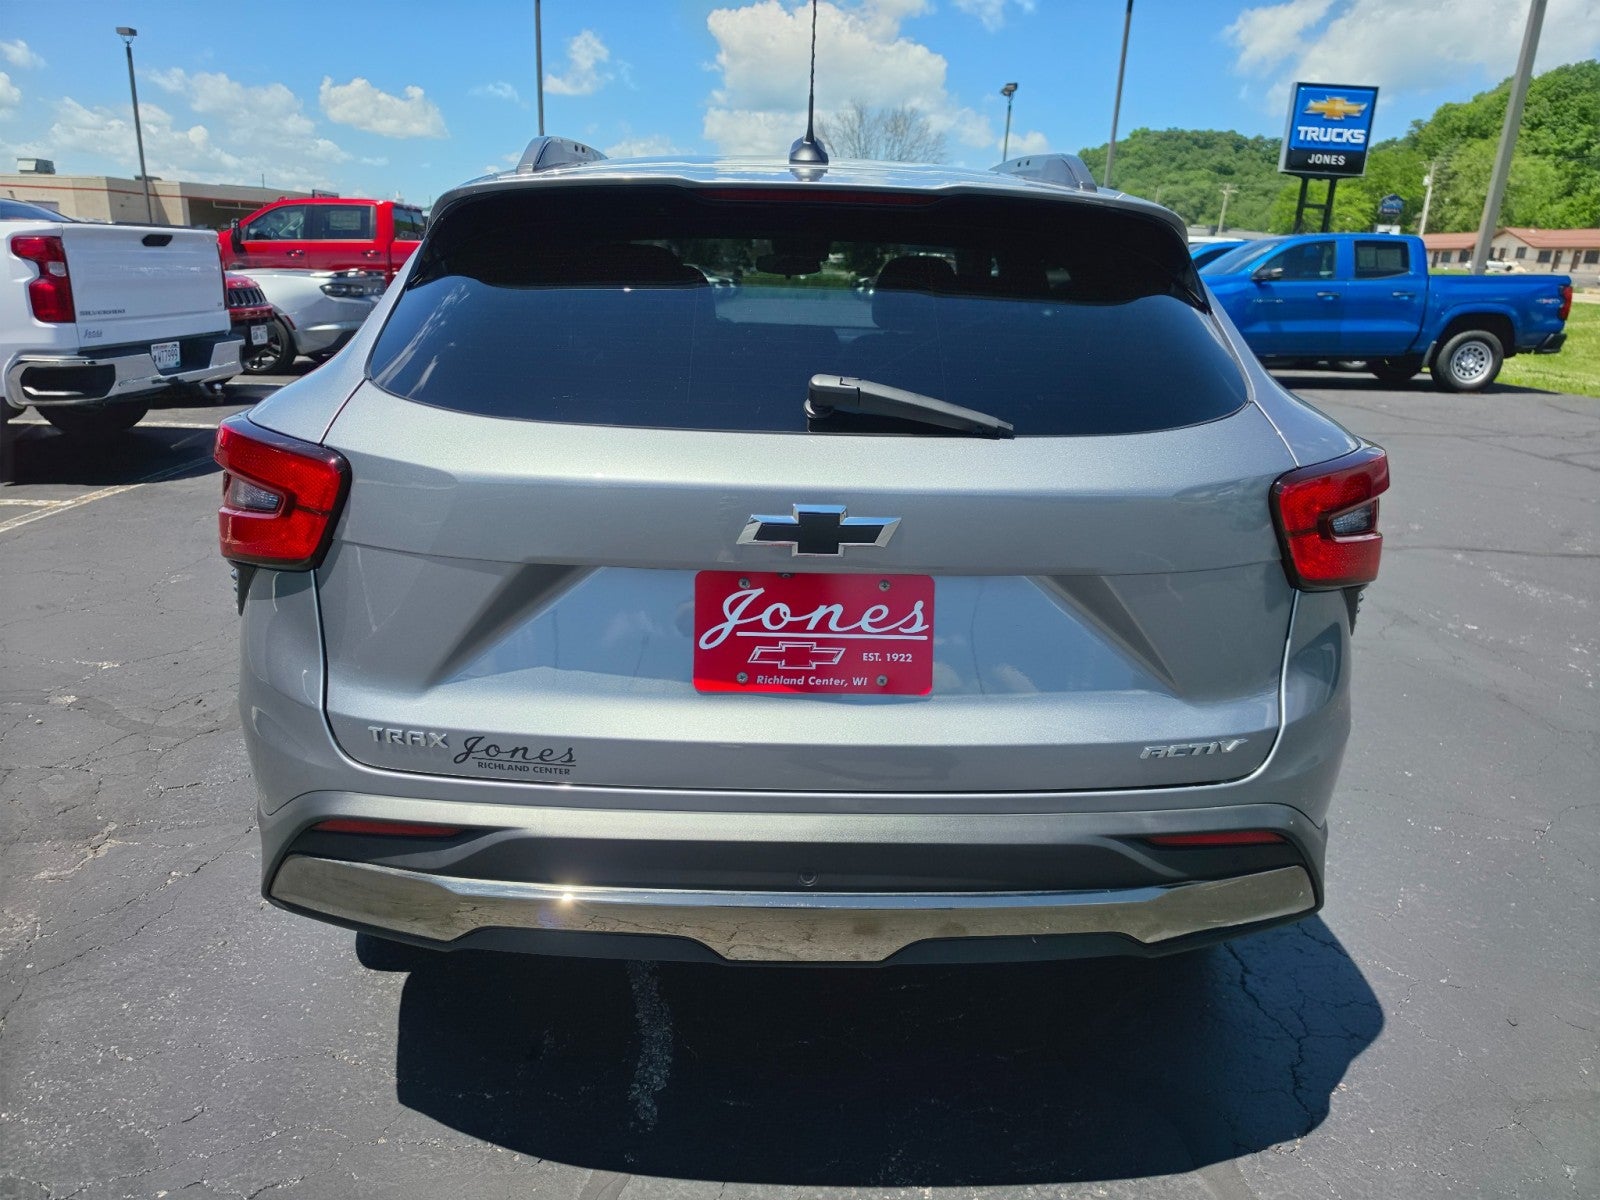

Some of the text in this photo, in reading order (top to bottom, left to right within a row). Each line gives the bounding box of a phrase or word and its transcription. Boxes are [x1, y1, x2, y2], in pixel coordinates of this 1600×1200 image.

[1297, 126, 1366, 144] TRUCKS
[1307, 154, 1346, 166] JONES
[699, 587, 930, 650] Jones
[862, 652, 913, 663] EST. 1922
[756, 675, 868, 688] Richland Center, WI
[367, 726, 449, 749] TRAX
[453, 736, 577, 764] Jones
[1139, 738, 1248, 759] ACTIV
[477, 761, 571, 775] RICHLAND CENTER
